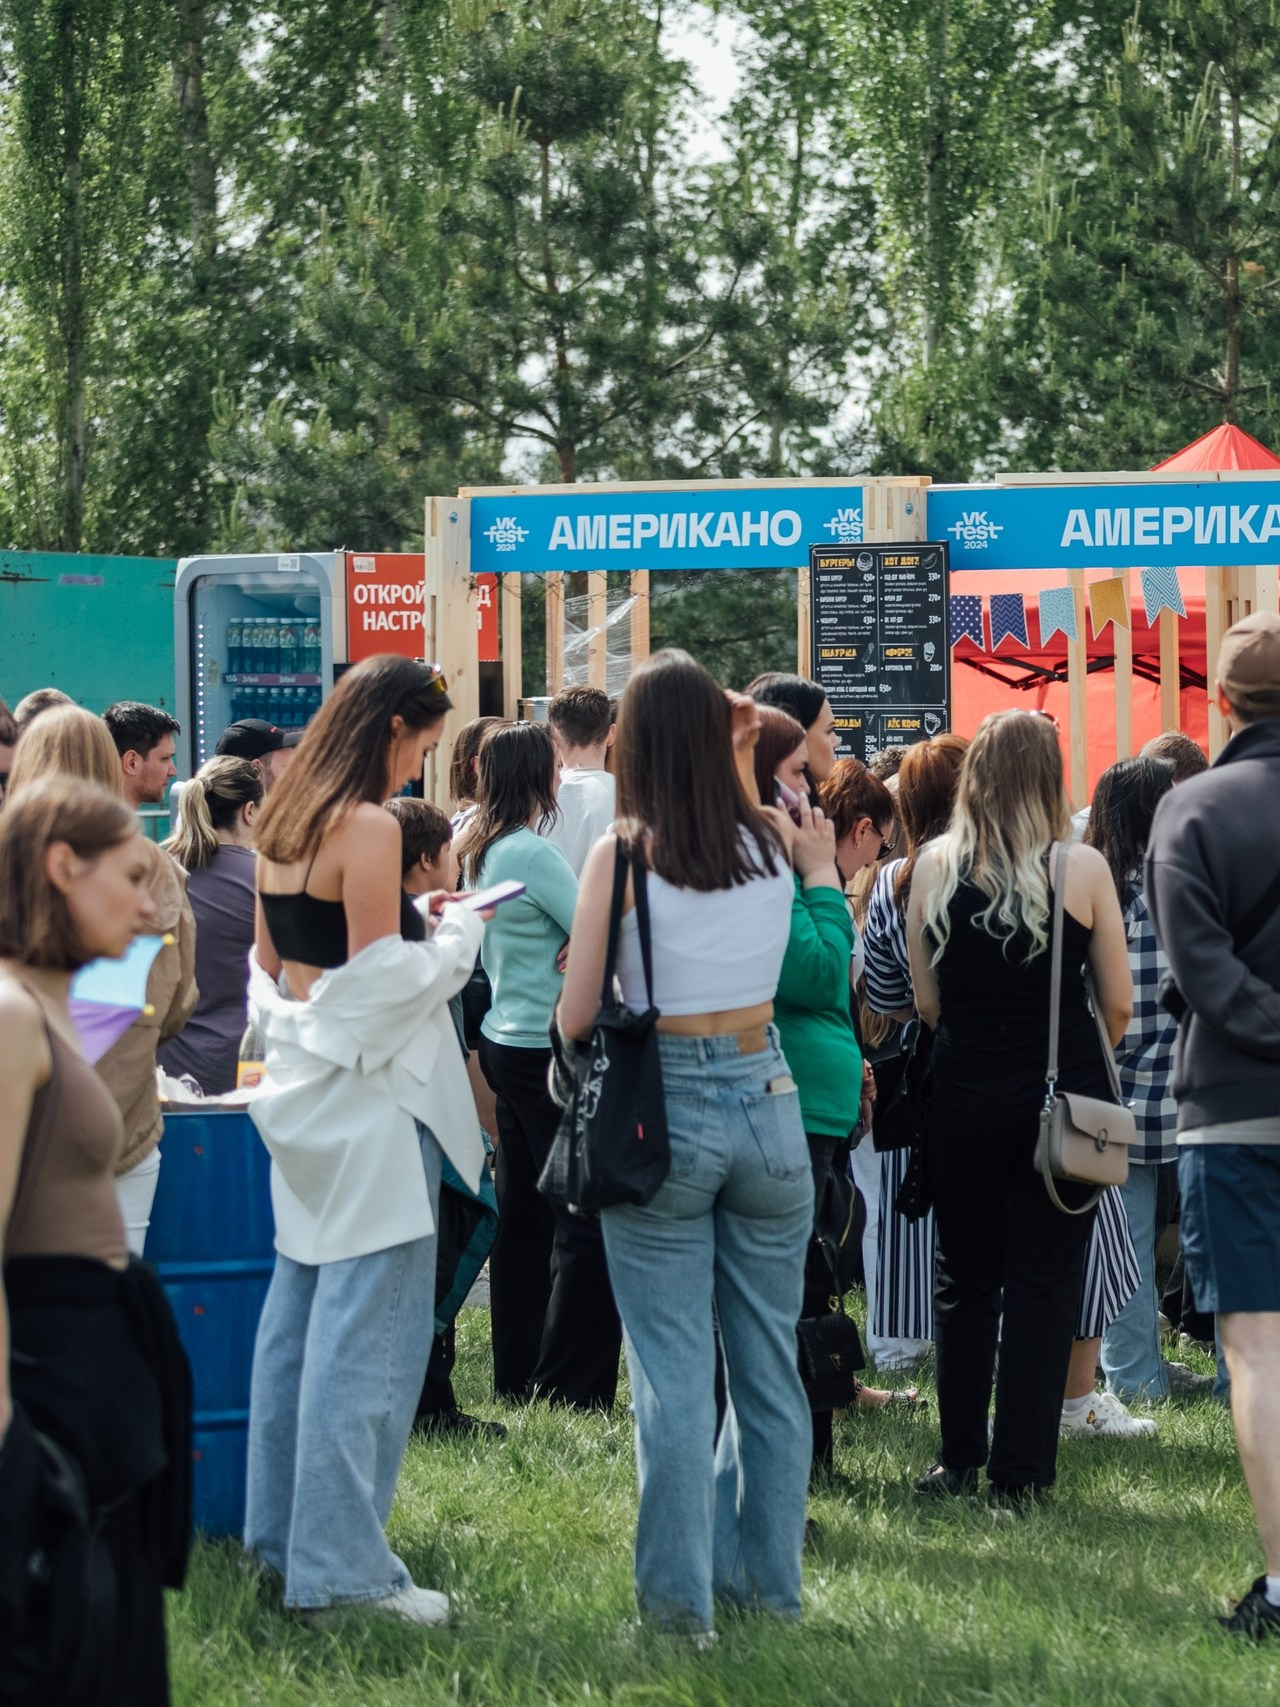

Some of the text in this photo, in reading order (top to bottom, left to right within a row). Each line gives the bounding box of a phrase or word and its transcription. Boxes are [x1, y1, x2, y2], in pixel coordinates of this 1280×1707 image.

[838, 508, 861, 522] VK
[962, 511, 988, 525] VK
[496, 517, 517, 529] VK
[548, 509, 802, 551] АМЕРИКАНО
[483, 525, 530, 543] fest
[947, 521, 1004, 540] fest
[496, 543, 516, 552] 2024
[964, 541, 988, 549] 2024
[884, 557, 898, 566] ХОТ
[353, 580, 425, 604] ОТКРОЙ
